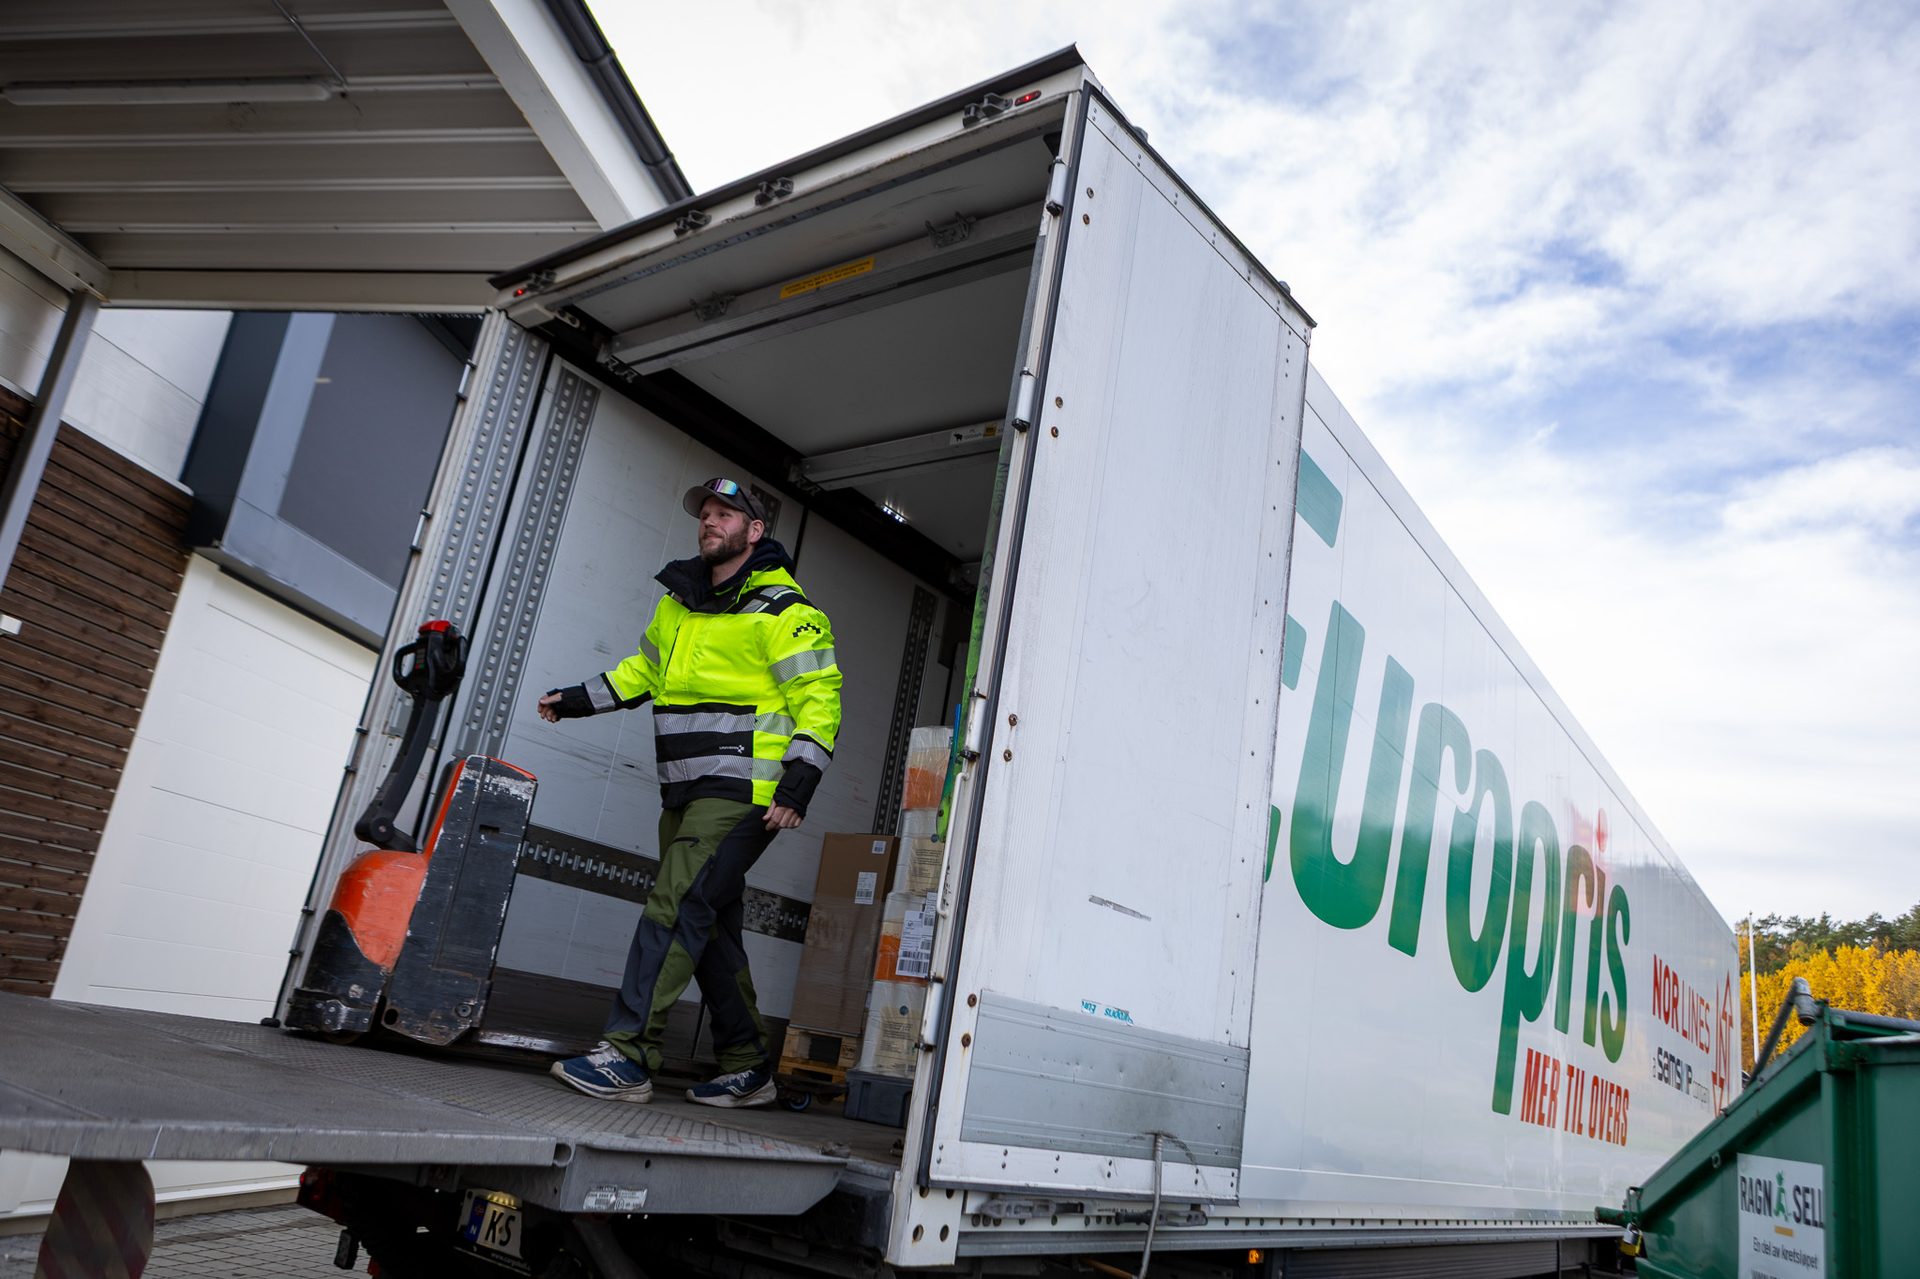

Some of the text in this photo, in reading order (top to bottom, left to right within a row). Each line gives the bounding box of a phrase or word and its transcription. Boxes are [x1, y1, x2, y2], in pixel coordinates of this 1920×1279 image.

[1652, 954, 1711, 1055] NOR LINES
[1520, 1047, 1629, 1147] MER TIL OVERS
[470, 1225, 478, 1235] N
[484, 1209, 516, 1247] KS
[1752, 1236, 1760, 1253] En
[1761, 1239, 1772, 1256] del
[1772, 1245, 1780, 1258] av
